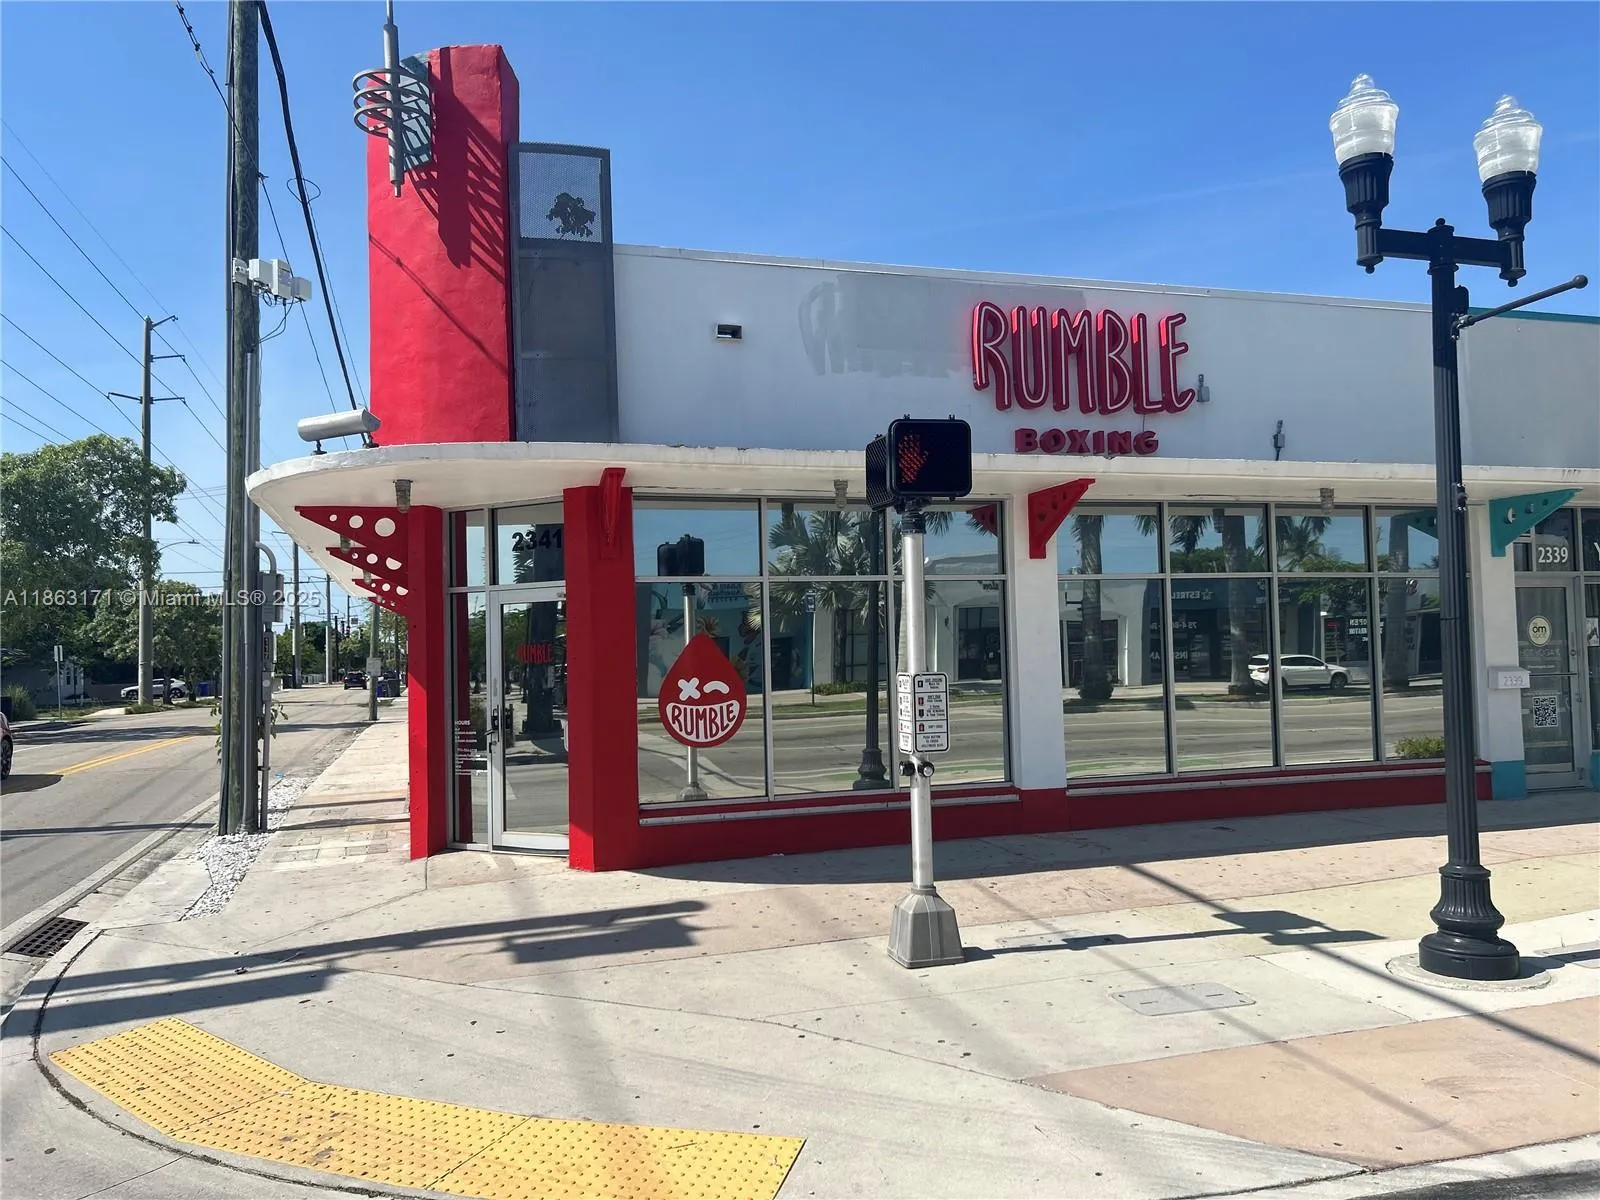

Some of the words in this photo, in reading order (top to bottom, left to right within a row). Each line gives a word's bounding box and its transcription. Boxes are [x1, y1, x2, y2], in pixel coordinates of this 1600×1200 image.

[971, 301, 1196, 415] RUMBLE
[1014, 428, 1159, 455] BOXING
[511, 528, 563, 552] 2341
[1537, 546, 1569, 563] 2339
[517, 643, 553, 664] RUMBLE
[671, 702, 736, 739] RUMBLE
